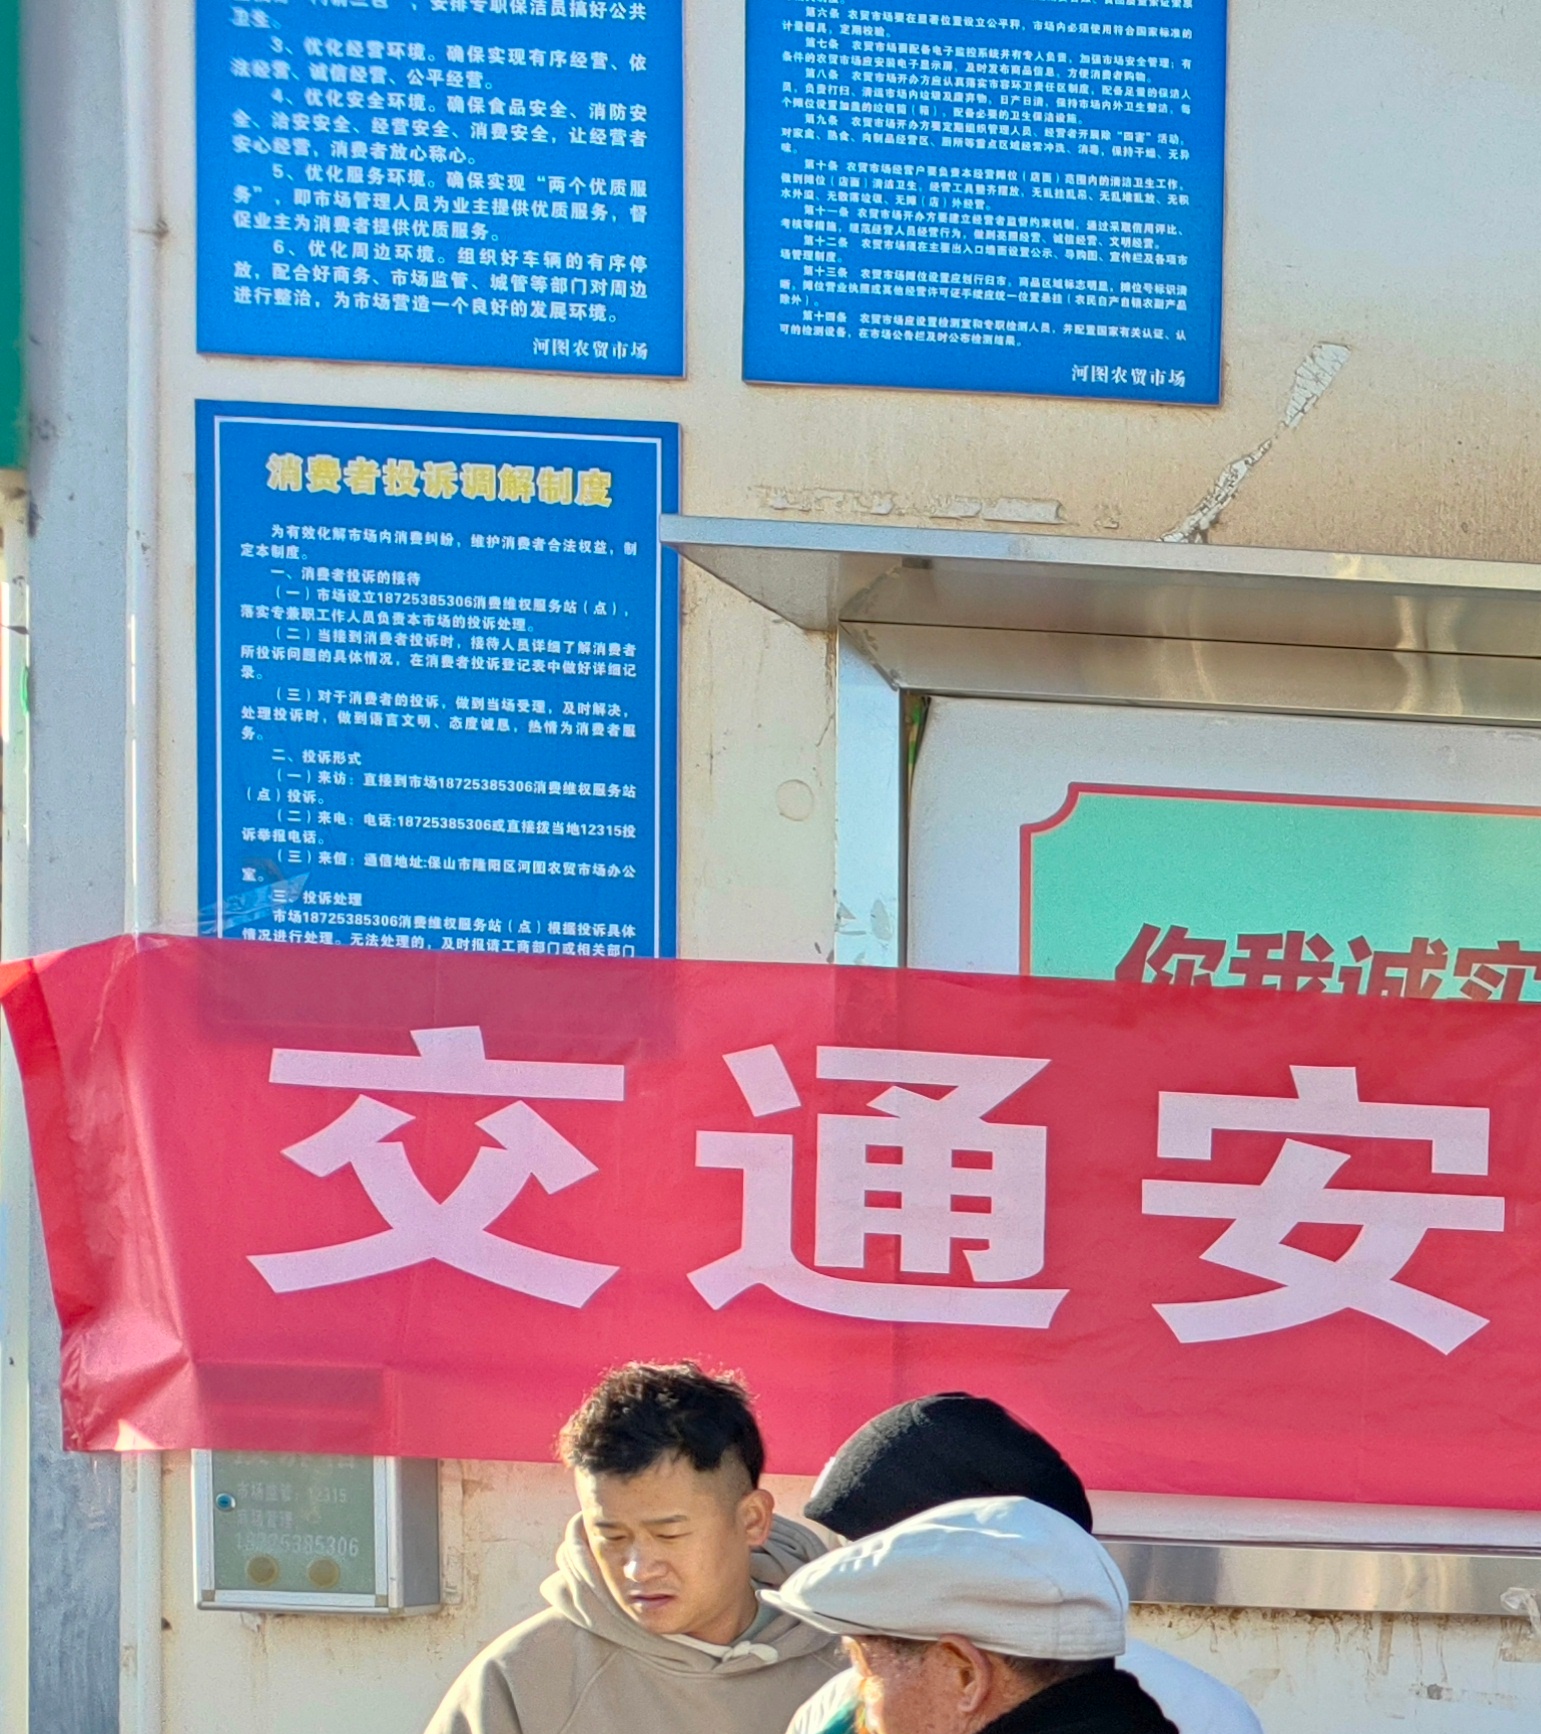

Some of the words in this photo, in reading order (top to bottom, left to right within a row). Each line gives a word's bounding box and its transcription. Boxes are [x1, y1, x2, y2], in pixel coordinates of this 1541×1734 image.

[532, 336, 648, 361] 河图农贸市场
[1071, 364, 1187, 388] 河图农贸市场
[266, 453, 612, 508] 消费者投诉调解制度
[240, 542, 308, 561] 定本制度。
